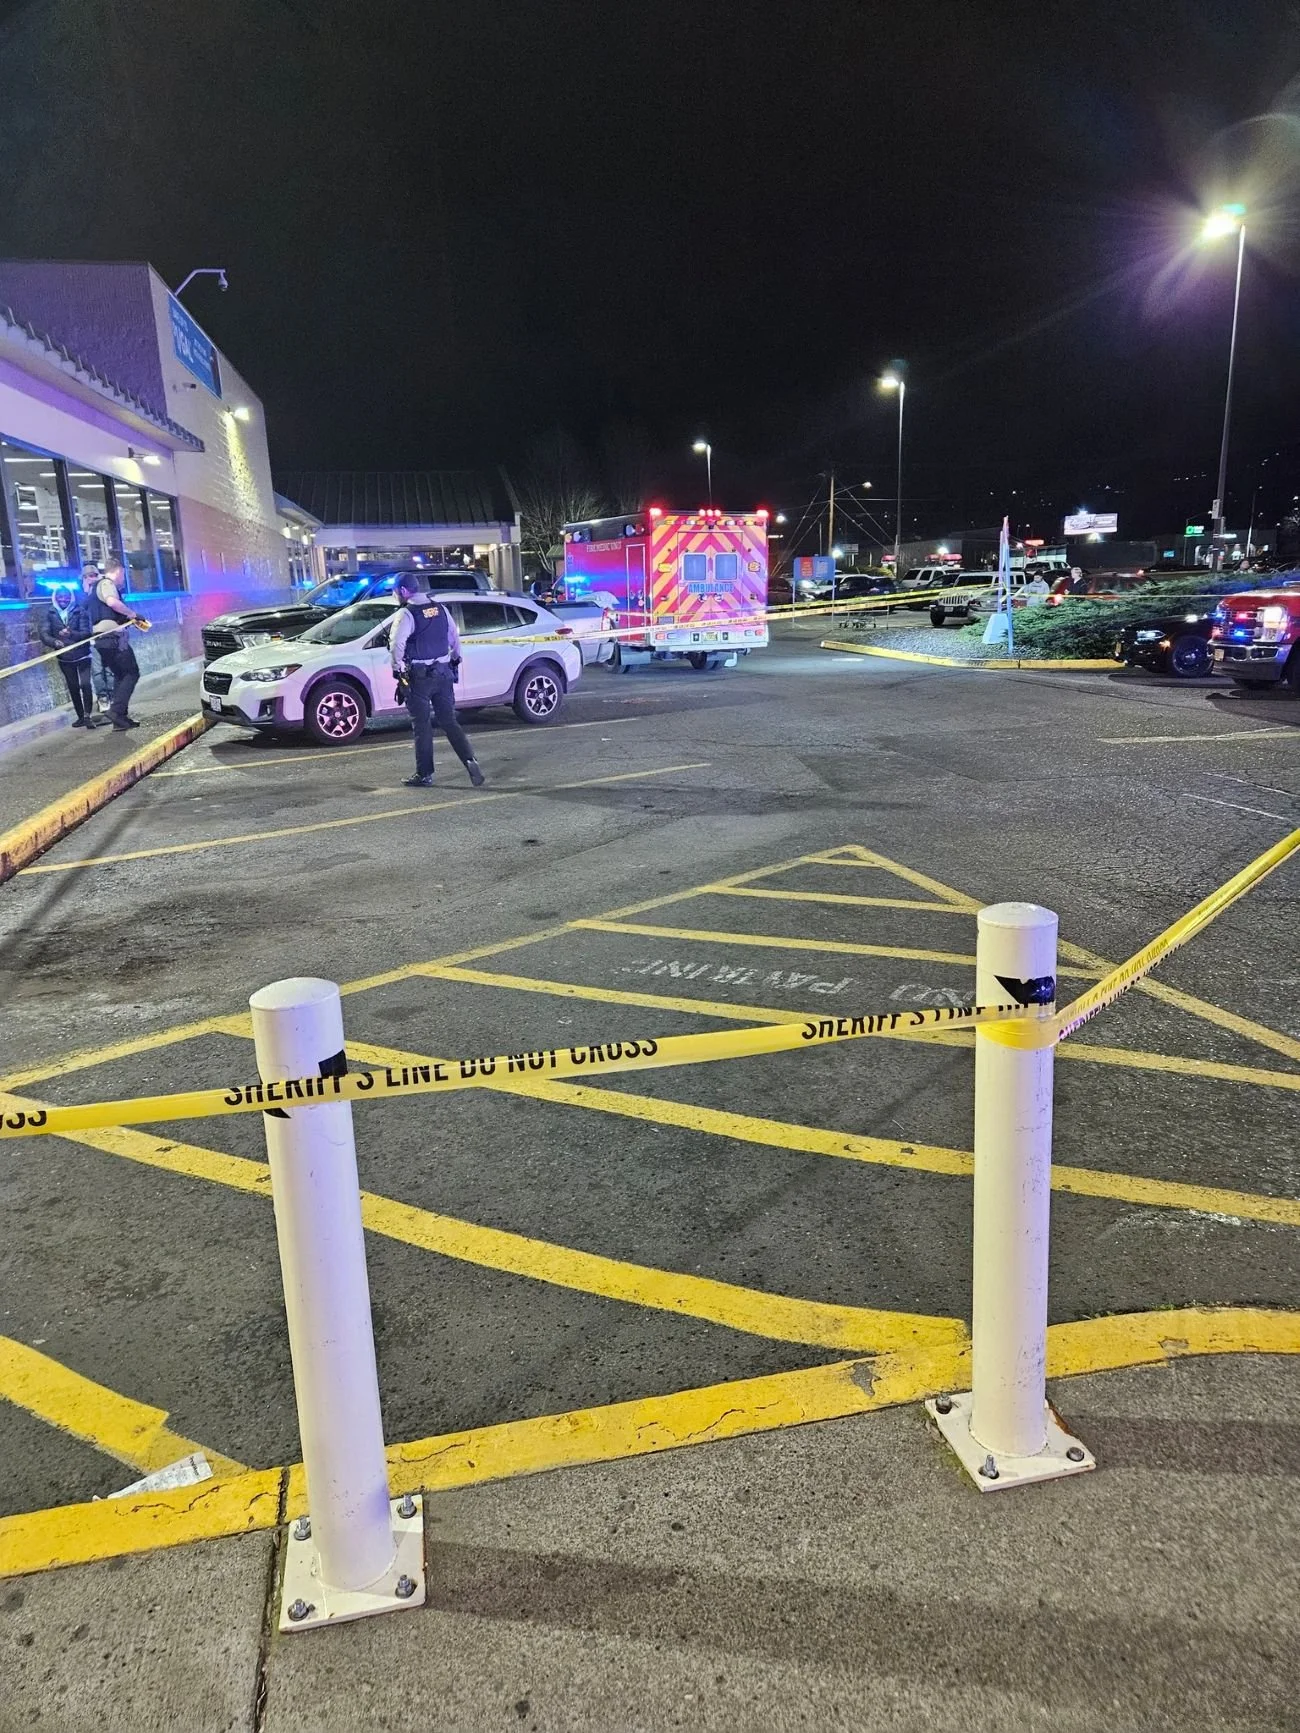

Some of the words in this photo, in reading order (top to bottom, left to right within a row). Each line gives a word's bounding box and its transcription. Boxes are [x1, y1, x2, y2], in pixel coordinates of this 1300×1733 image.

[687, 582, 734, 593] AMBULANCE
[801, 1011, 925, 1040] SHERIFFS
[224, 1072, 374, 1106] SHERIFFS
[386, 1063, 449, 1087] LINE
[460, 1056, 495, 1078] DO
[508, 1049, 556, 1072] NOT
[570, 1039, 658, 1065] CROSS
